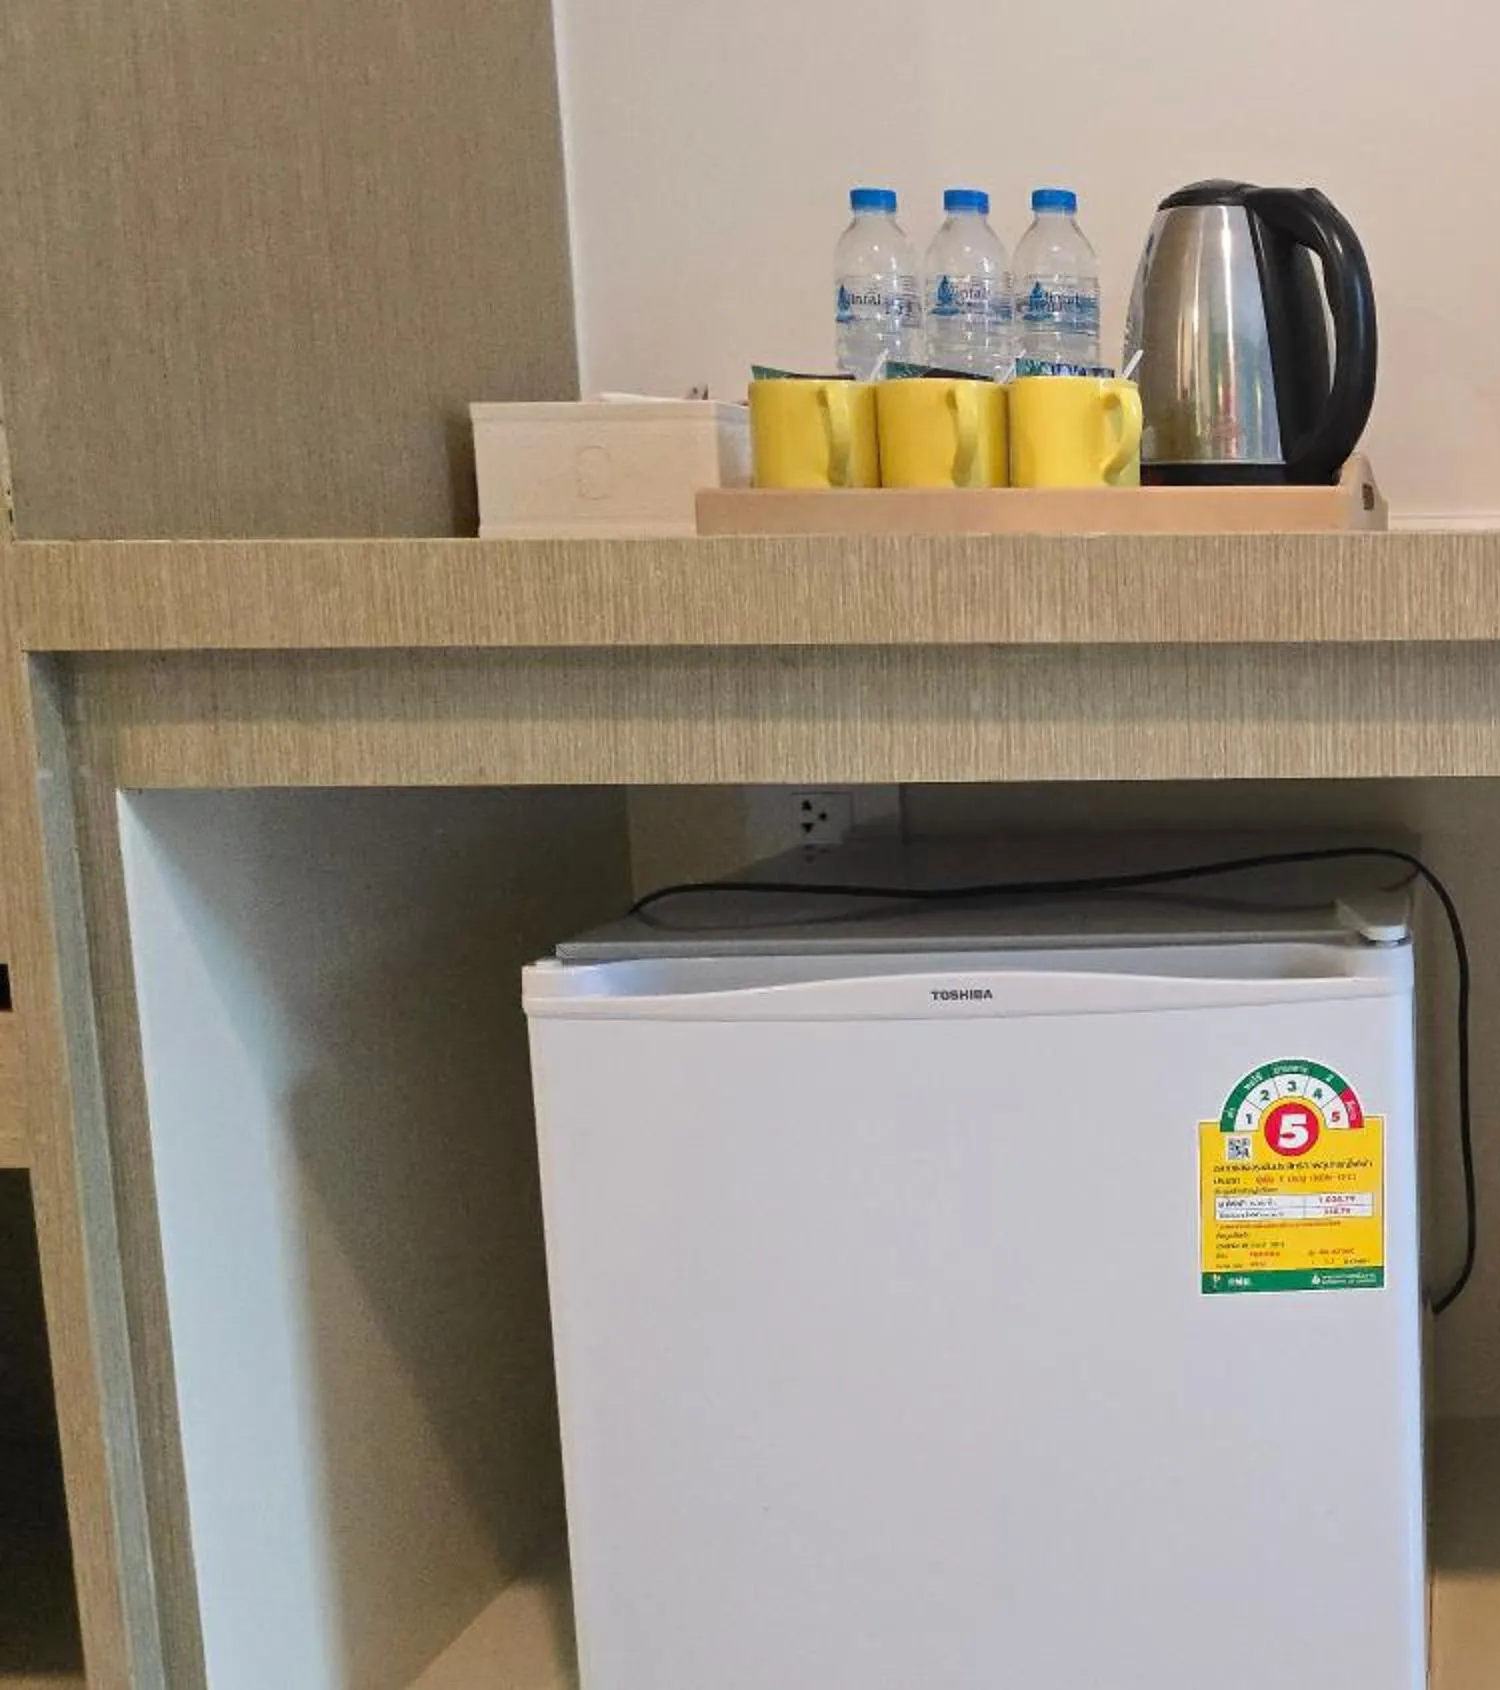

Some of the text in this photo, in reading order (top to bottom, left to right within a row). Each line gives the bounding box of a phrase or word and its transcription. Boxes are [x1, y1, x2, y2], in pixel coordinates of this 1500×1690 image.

[930, 988, 994, 1001] TOSHIBA
[1245, 1081, 1341, 1125] 1 2 3 4 5
[1278, 1112, 1310, 1150] 5
